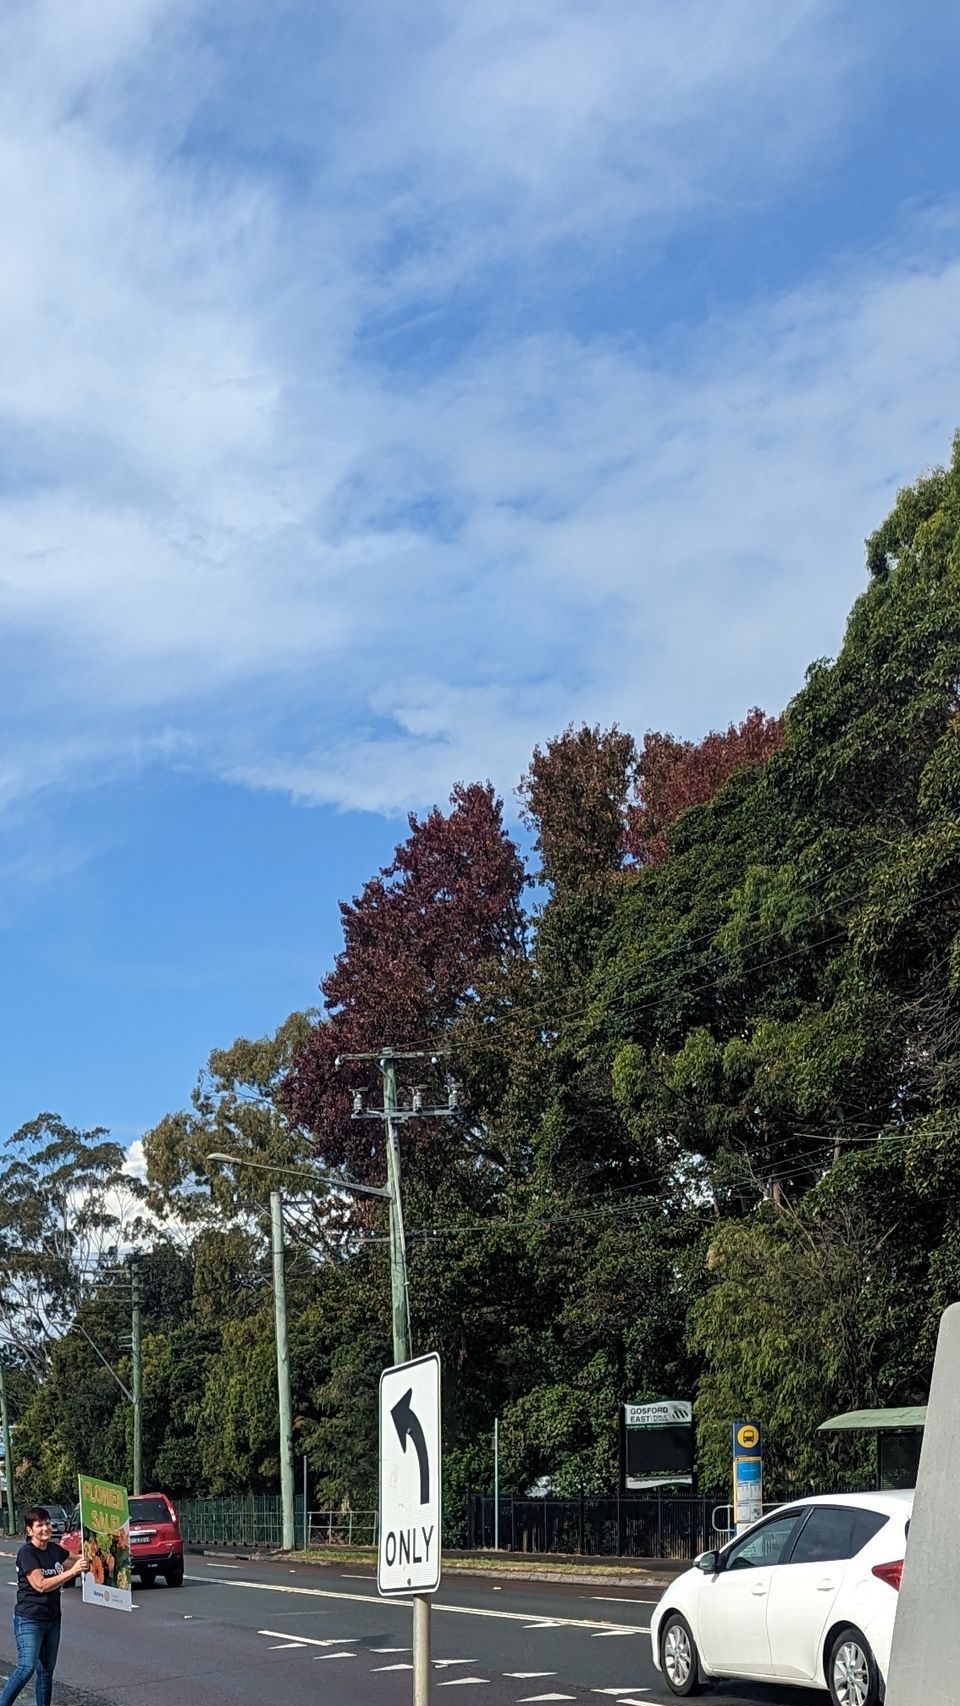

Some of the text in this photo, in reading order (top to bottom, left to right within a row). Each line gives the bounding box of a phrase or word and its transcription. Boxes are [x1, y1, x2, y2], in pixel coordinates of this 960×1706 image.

[630, 1406, 668, 1415] GOSFORD
[630, 1415, 650, 1423] EAST
[385, 1525, 434, 1567] ONLY
